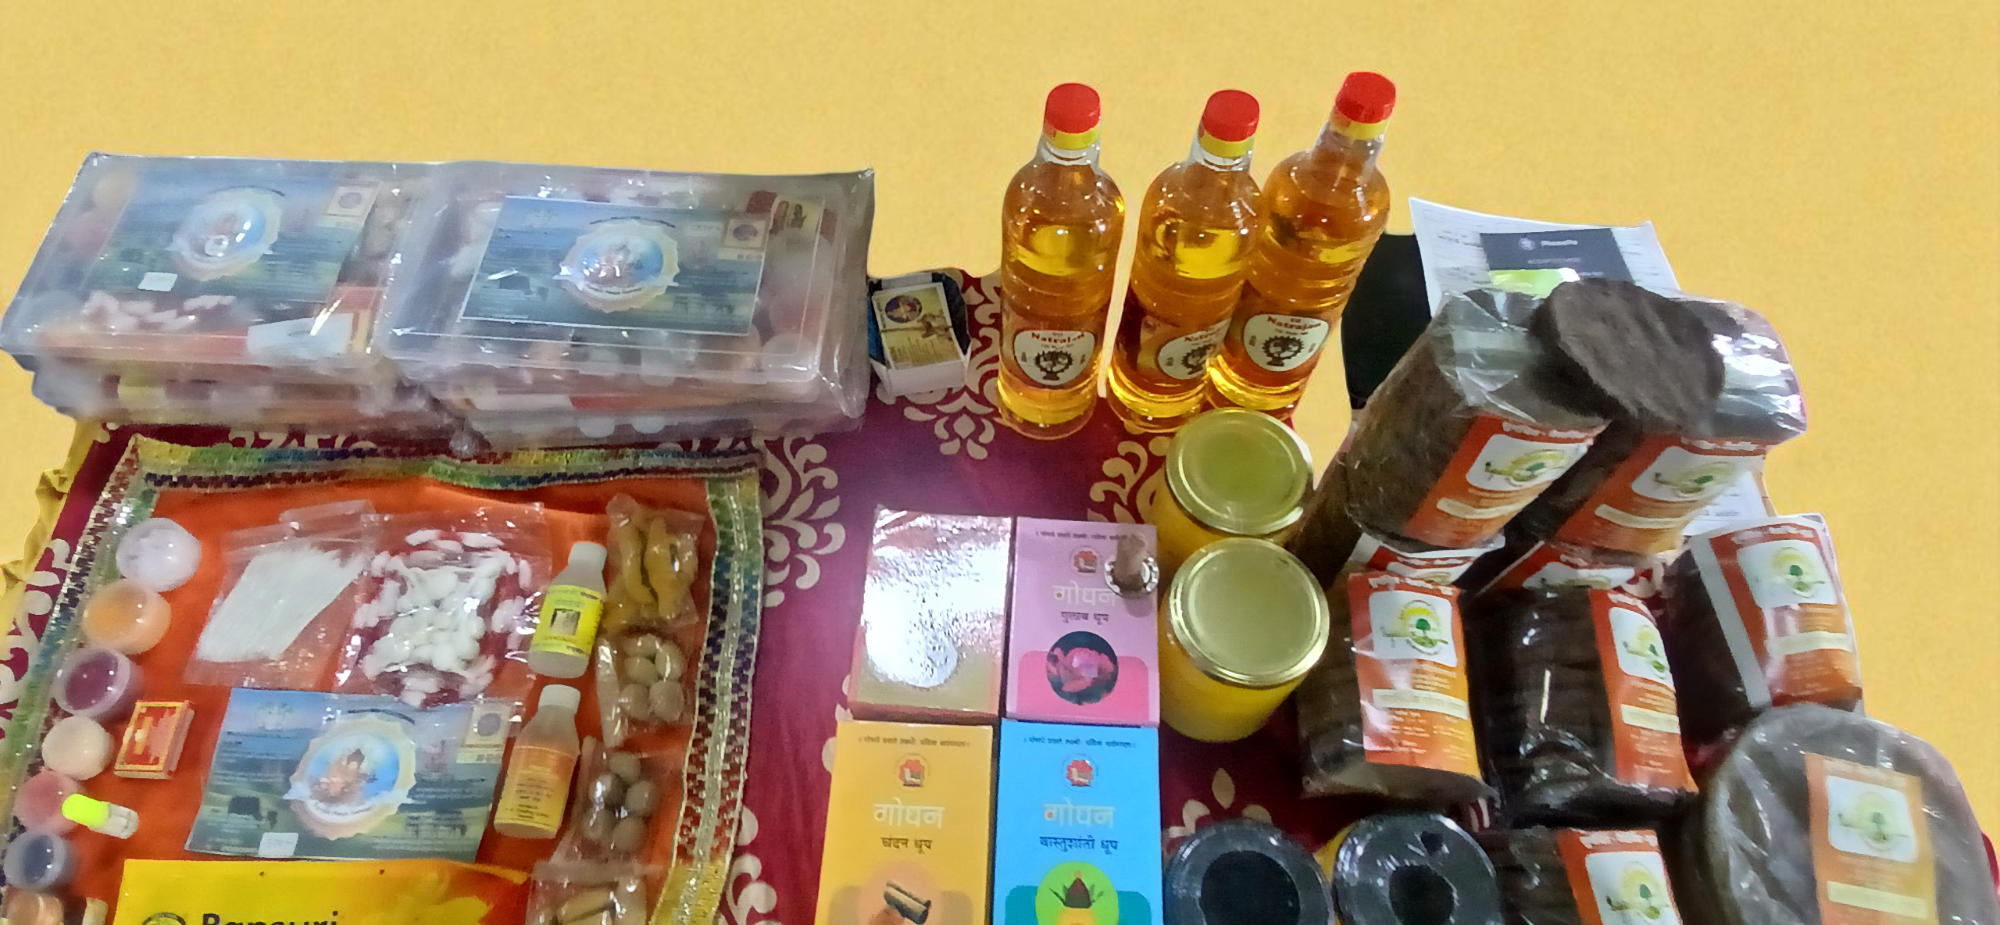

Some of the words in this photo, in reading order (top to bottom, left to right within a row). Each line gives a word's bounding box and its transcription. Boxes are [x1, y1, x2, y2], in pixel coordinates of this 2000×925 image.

[1052, 579, 1117, 607] गोधन
[872, 796, 945, 829] गोधन
[1042, 796, 1116, 829] गोधन
[880, 835, 910, 850] चंदन
[913, 838, 934, 854] धूप
[1100, 839, 1119, 855] धूप
